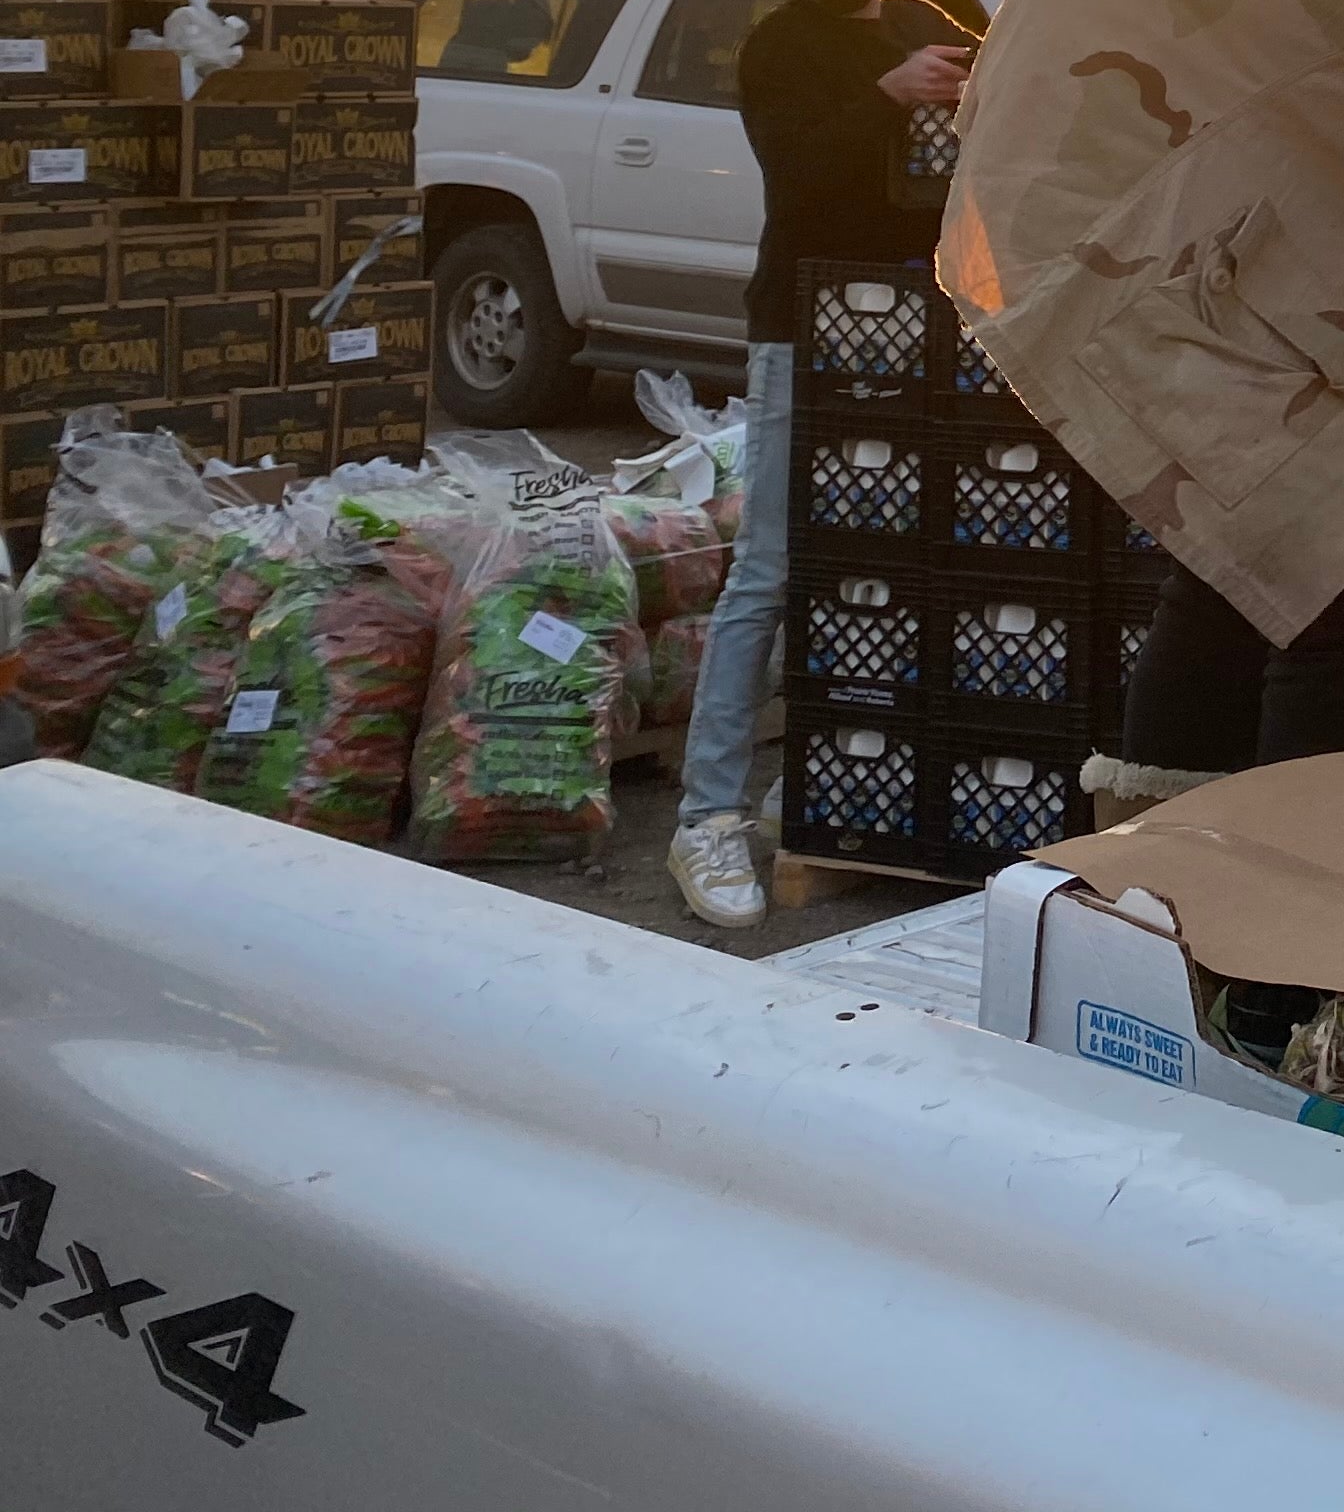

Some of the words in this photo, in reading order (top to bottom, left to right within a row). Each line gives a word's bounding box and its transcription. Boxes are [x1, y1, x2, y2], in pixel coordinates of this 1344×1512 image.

[343, 34, 406, 70] CROWN
[342, 131, 410, 164] CROWN
[79, 338, 158, 374] CROWN
[1090, 1010, 1142, 1044] ALWAYS
[1145, 1029, 1183, 1062] SWEET
[1089, 1033, 1099, 1052] &
[1101, 1036, 1141, 1066] READY
[1144, 1051, 1159, 1074] TO
[1161, 1058, 1184, 1084] EAT
